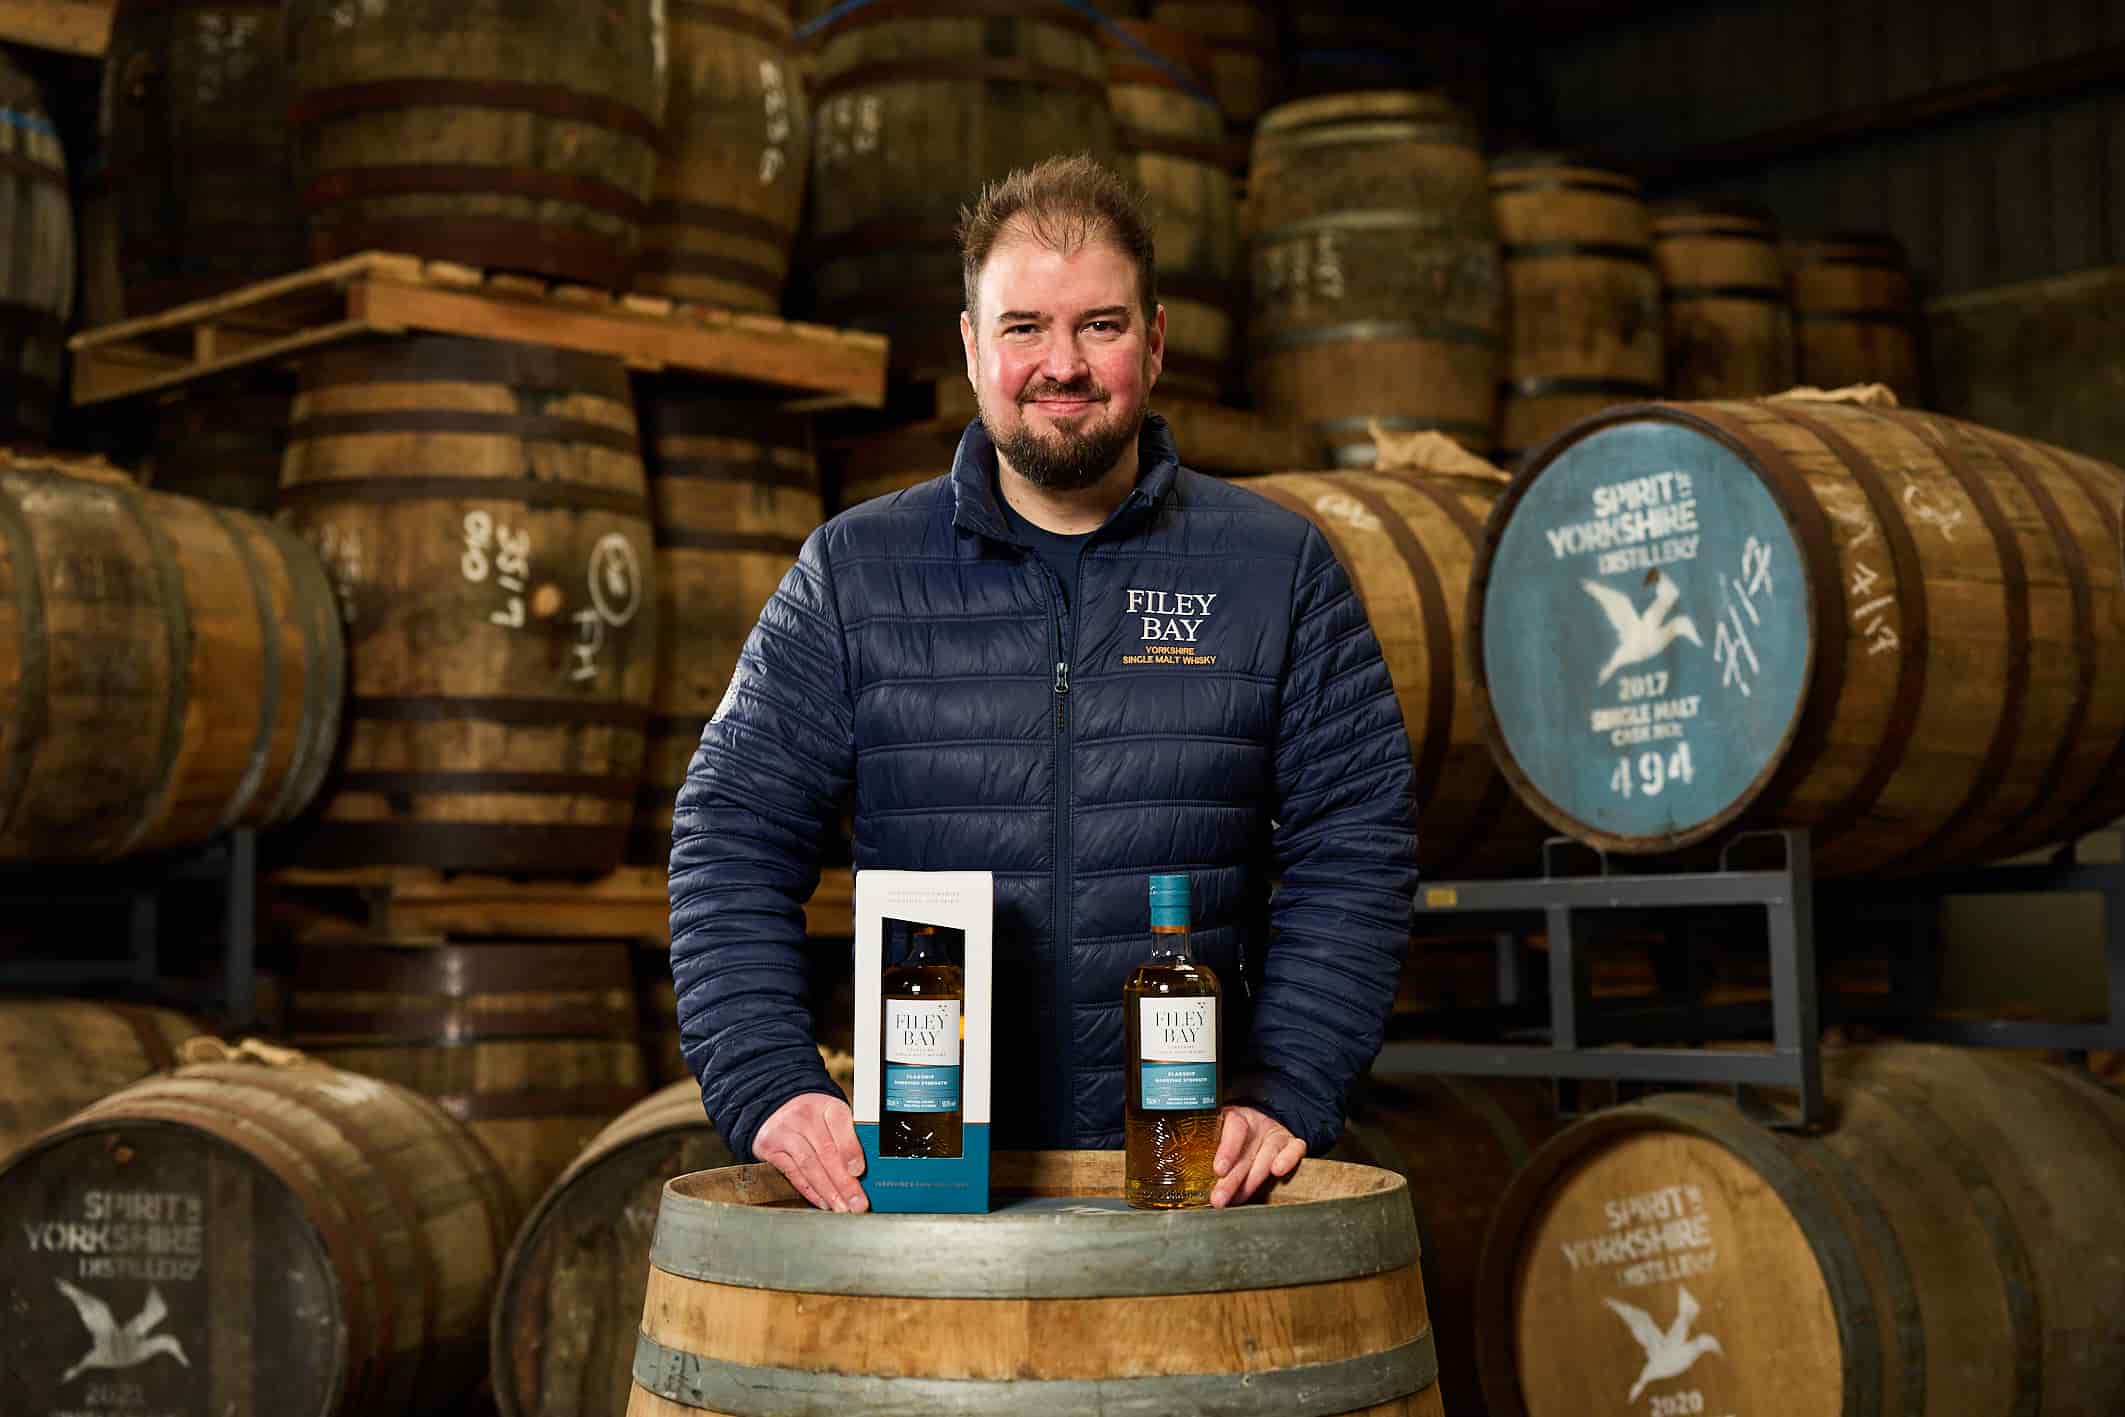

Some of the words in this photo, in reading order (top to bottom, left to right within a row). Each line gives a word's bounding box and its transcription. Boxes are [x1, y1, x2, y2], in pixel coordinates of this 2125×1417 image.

[1593, 472, 1674, 517] SPIRIT
[1545, 499, 1698, 560] YORKSHIRE
[1126, 589, 1217, 615] FILEY
[1140, 616, 1204, 642] BAY
[1122, 655, 1154, 665] SINGLE
[1155, 655, 1181, 664] MALT
[1182, 656, 1217, 665] WHISKY
[1145, 646, 1196, 656] YORKSHIRE
[1618, 671, 1668, 700] 2017
[1610, 741, 1694, 799] 494
[896, 1014, 946, 1030] FILEY
[1154, 1010, 1206, 1027] FILEY
[904, 1030, 939, 1046] BAY
[1164, 1027, 1200, 1043] BAY
[23, 1222, 203, 1252] YORKSHIRE
[1559, 1214, 1713, 1273] YORKSHIRE
